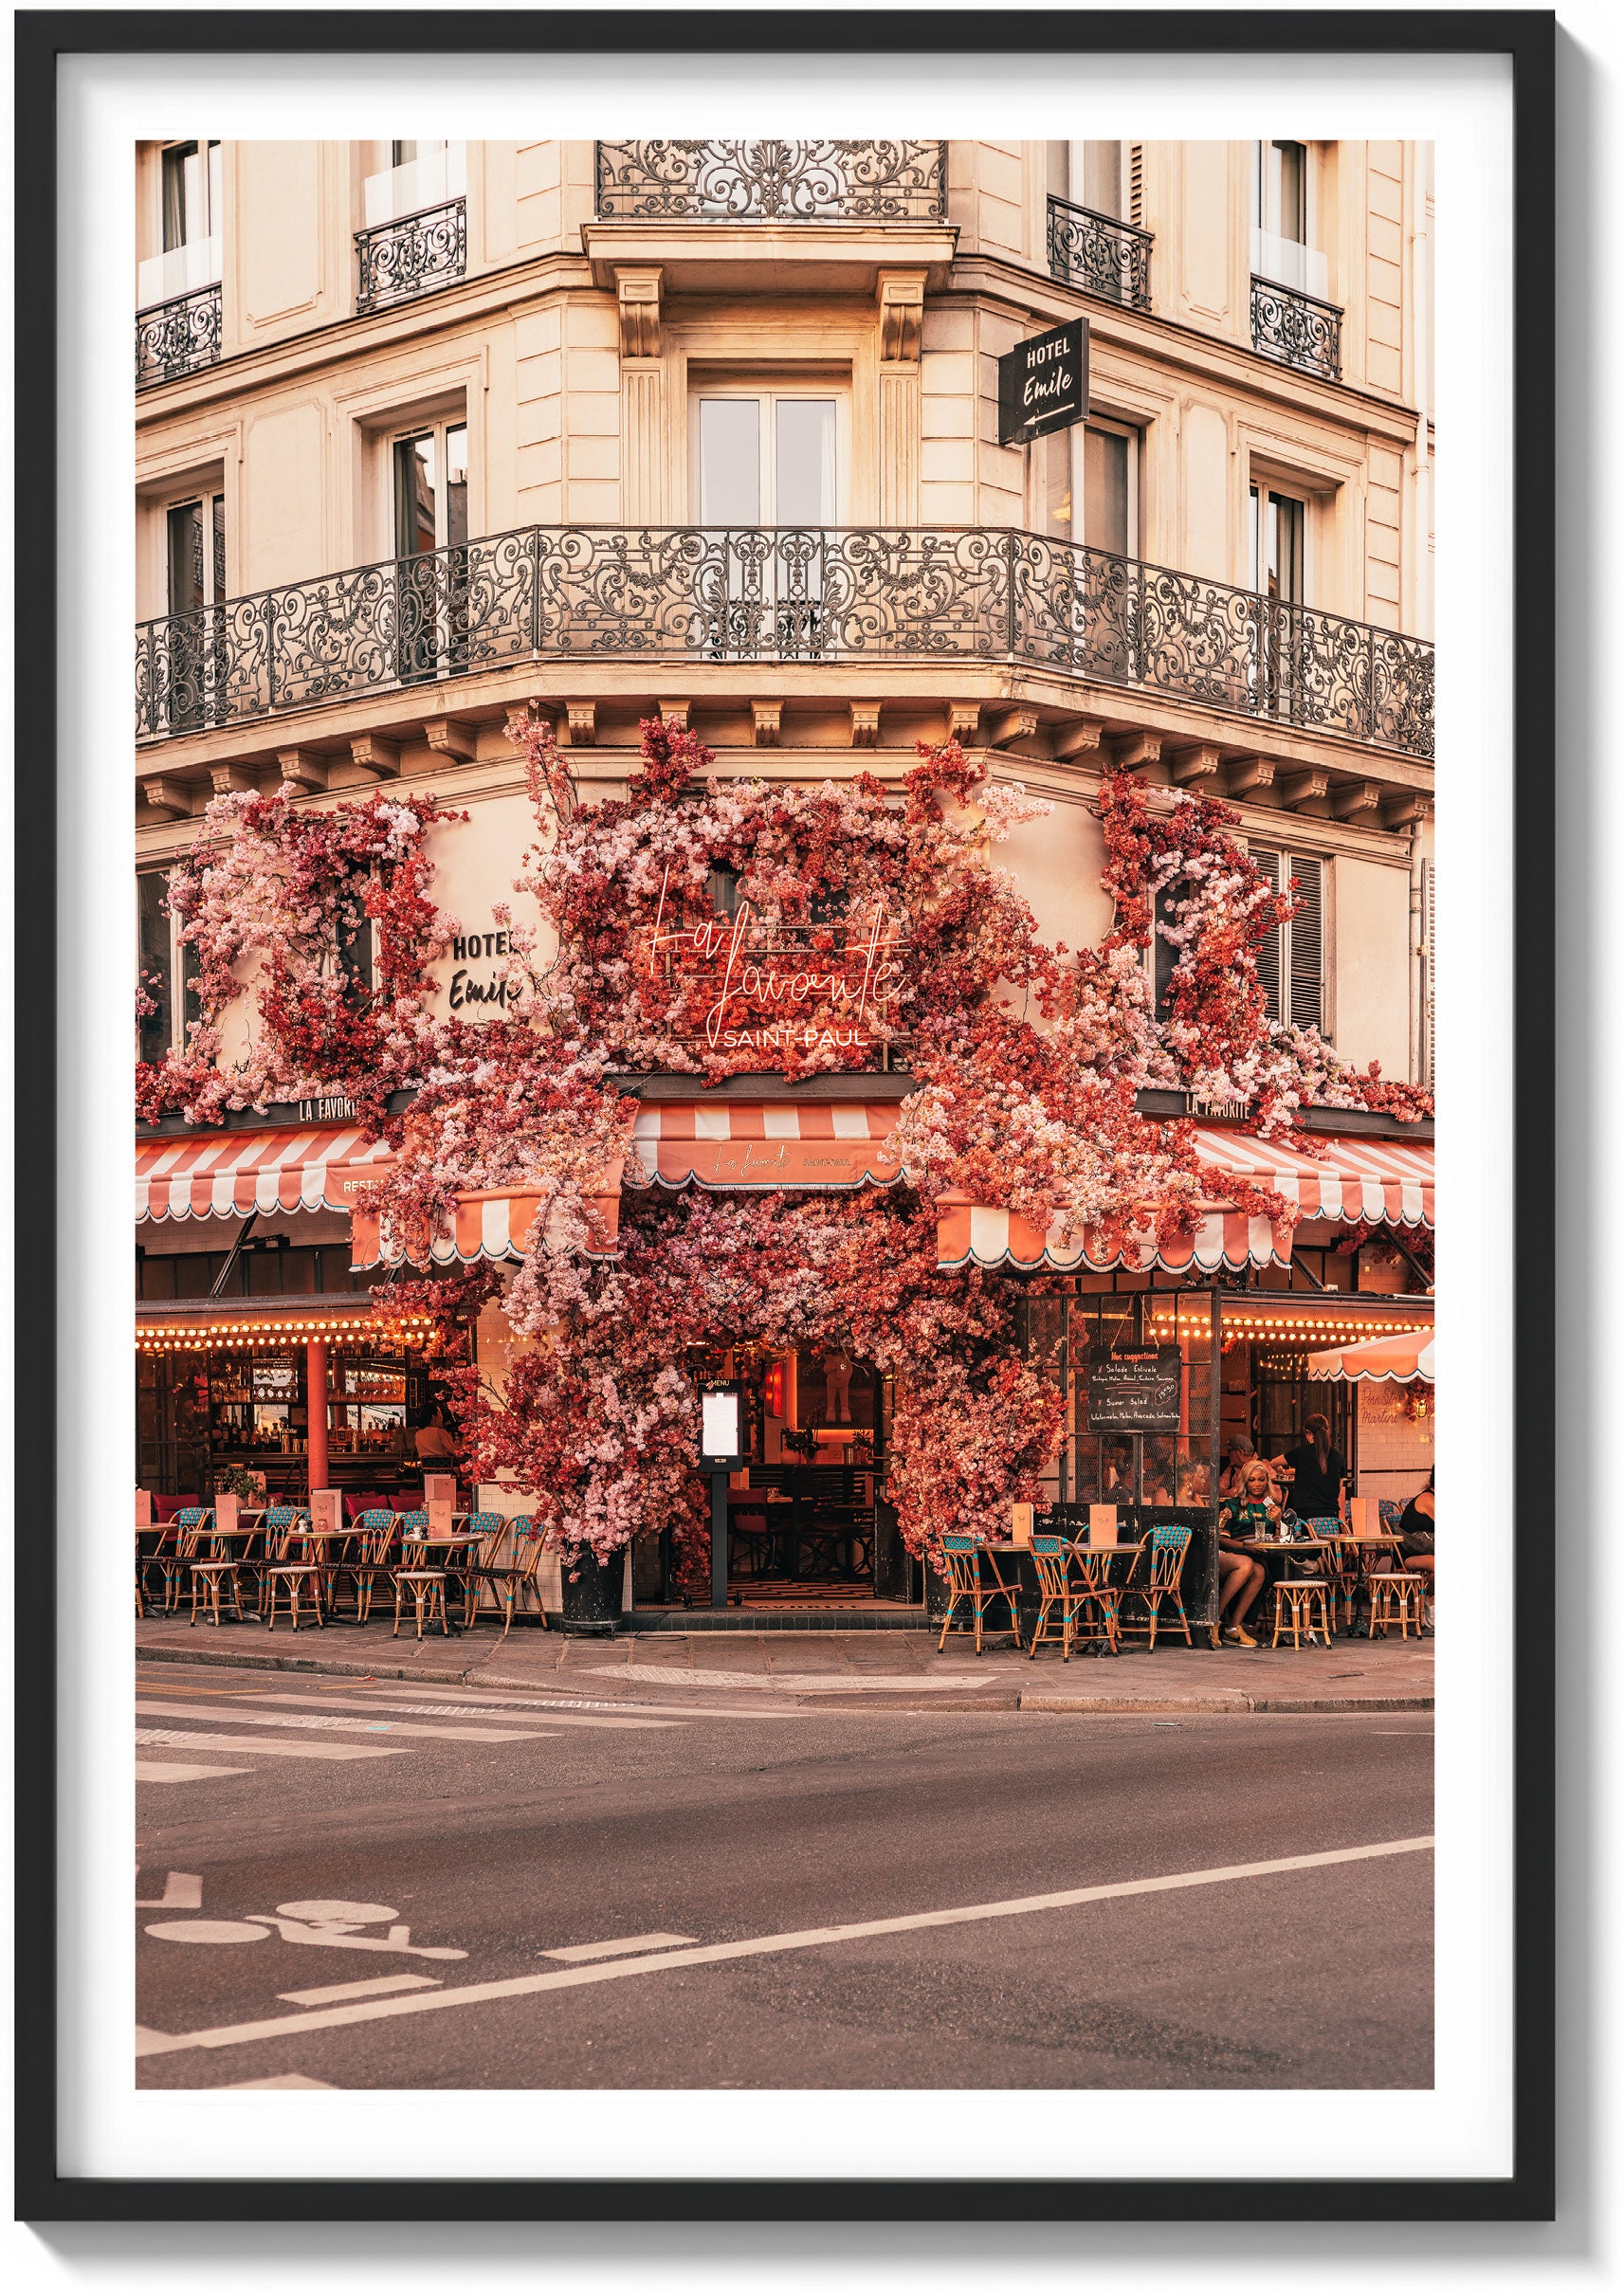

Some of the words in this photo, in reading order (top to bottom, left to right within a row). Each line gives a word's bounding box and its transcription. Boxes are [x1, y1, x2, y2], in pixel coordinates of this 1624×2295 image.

[1027, 337, 1070, 369] HOTEL
[1024, 366, 1073, 406] Emile
[645, 864, 723, 975] La
[453, 931, 519, 960] HOTEL
[706, 901, 909, 1048] favorite
[722, 1029, 868, 1047] SAINT-PAUL
[300, 1101, 313, 1121] LA
[319, 1097, 360, 1120] FAVORI
[1186, 1093, 1198, 1114] LA
[1105, 1363, 1128, 1374] Salade
[1124, 1353, 1159, 1362] suggestions
[1130, 1397, 1148, 1406] Salad
